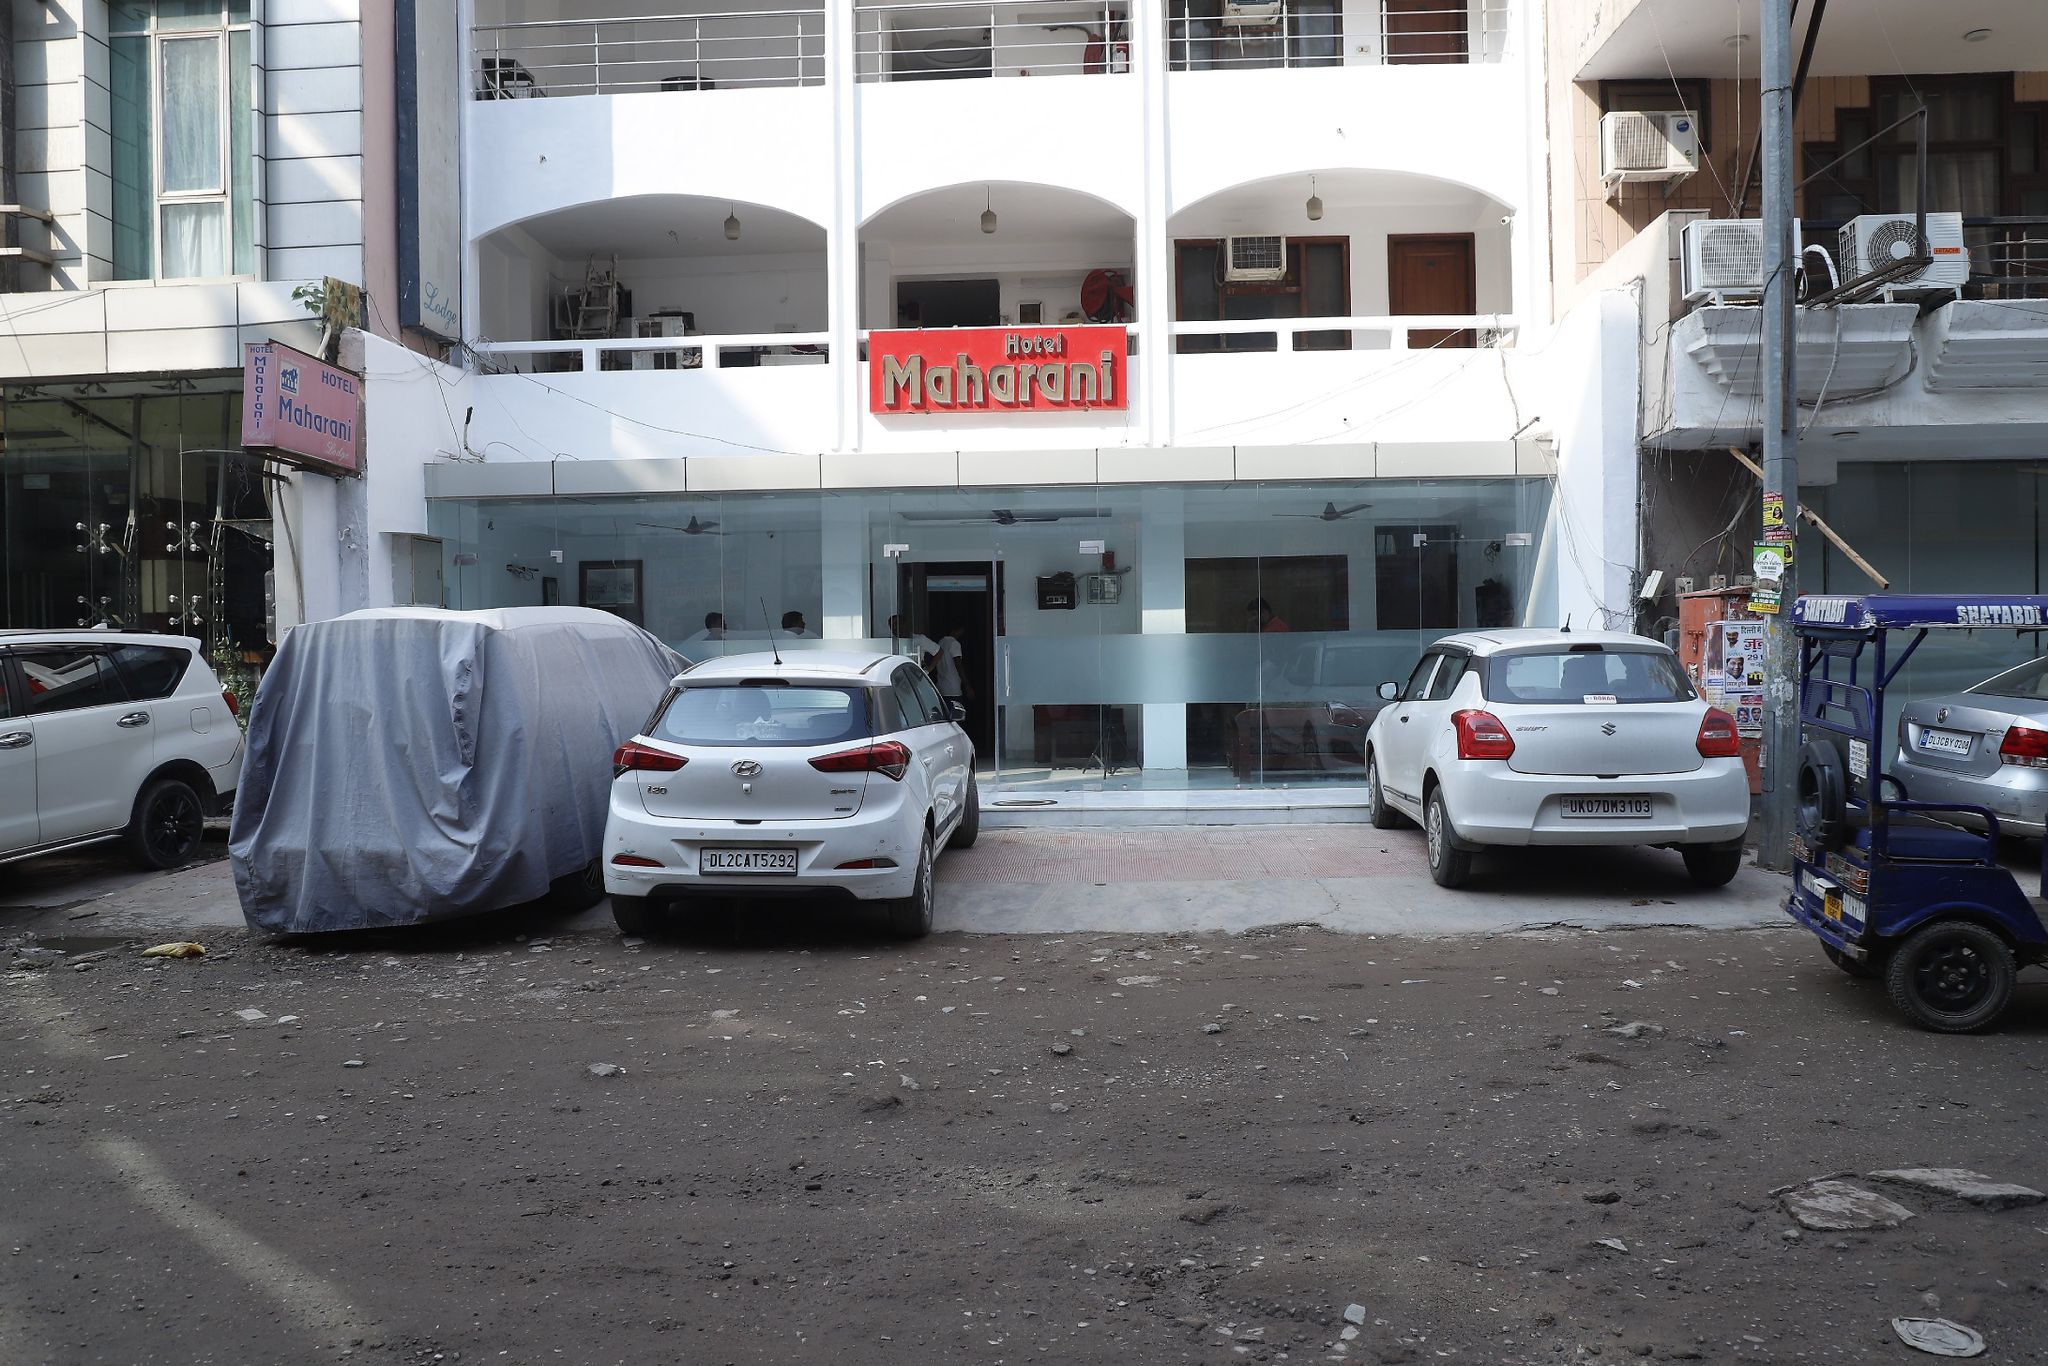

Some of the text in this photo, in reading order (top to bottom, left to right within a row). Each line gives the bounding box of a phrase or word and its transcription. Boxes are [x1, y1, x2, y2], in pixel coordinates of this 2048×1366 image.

[424, 281, 457, 330] Lodge
[250, 346, 274, 354] HOTEL
[1006, 333, 1062, 354] Hotel
[321, 370, 355, 395] HOTEL
[883, 351, 1113, 405] Maharani
[254, 356, 266, 429] Maharani
[279, 394, 352, 442] Maharani
[1803, 599, 1847, 622] SHATABDI
[647, 784, 668, 795] i20
[1570, 799, 1651, 813] UK07DM3103
[709, 853, 795, 868] DL2CAT5292
